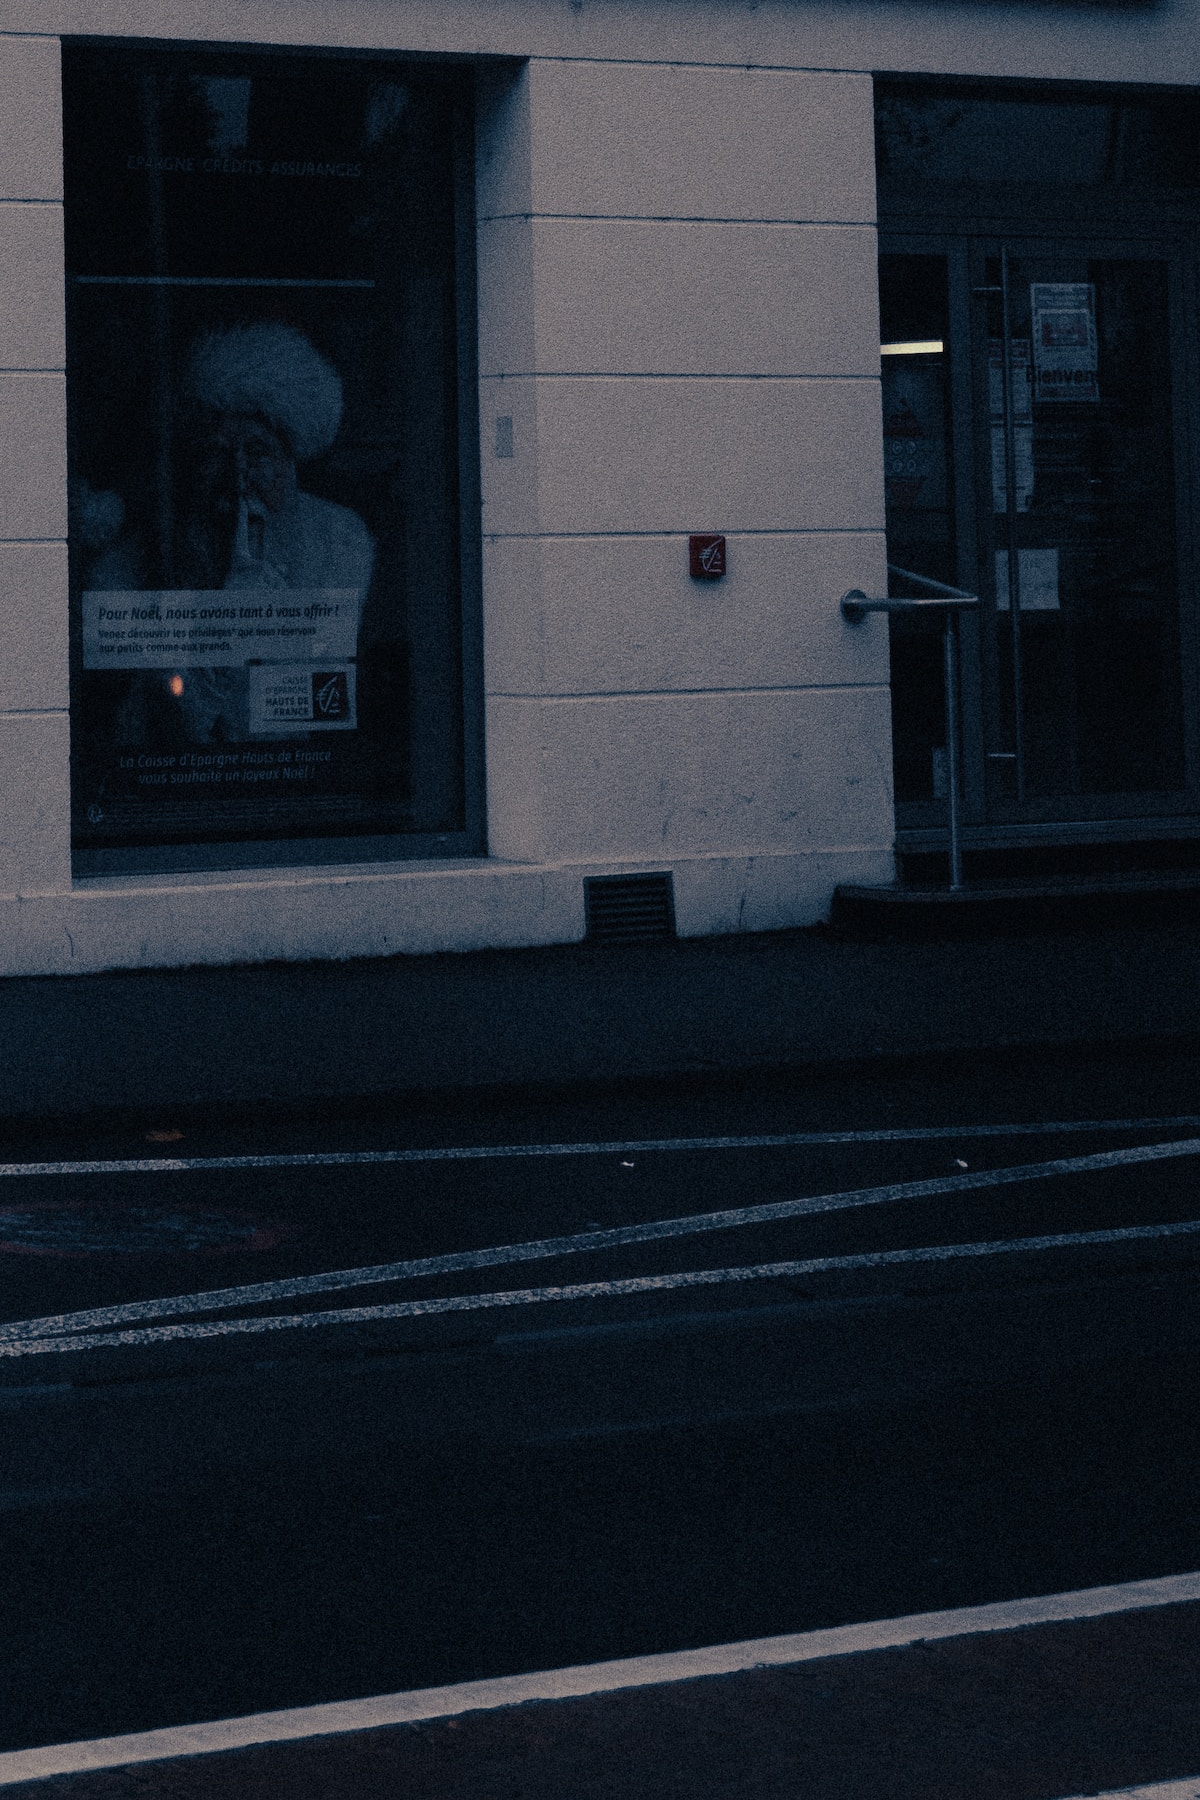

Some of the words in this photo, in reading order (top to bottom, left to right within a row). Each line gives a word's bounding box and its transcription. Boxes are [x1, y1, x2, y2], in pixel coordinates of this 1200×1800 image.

[269, 160, 362, 177] ASSURANCES
[1026, 365, 1100, 384] Bienven
[98, 607, 128, 621] Pour
[131, 604, 162, 622] Noël,
[166, 609, 198, 620] nous
[200, 608, 236, 619] avons
[239, 606, 263, 619] tant
[265, 604, 274, 618] à
[276, 607, 301, 618] vous
[98, 629, 125, 639] Venez
[127, 628, 170, 639] découvrir
[173, 628, 186, 638] les
[144, 644, 179, 653] comme
[265, 697, 295, 707] HAUTS
[298, 696, 309, 705] DE
[119, 755, 134, 768] La
[137, 754, 176, 767] Caisse
[241, 751, 274, 764] Hauts
[277, 749, 292, 763] de
[294, 749, 331, 763] France
[138, 774, 167, 784] vous
[225, 771, 240, 782] un
